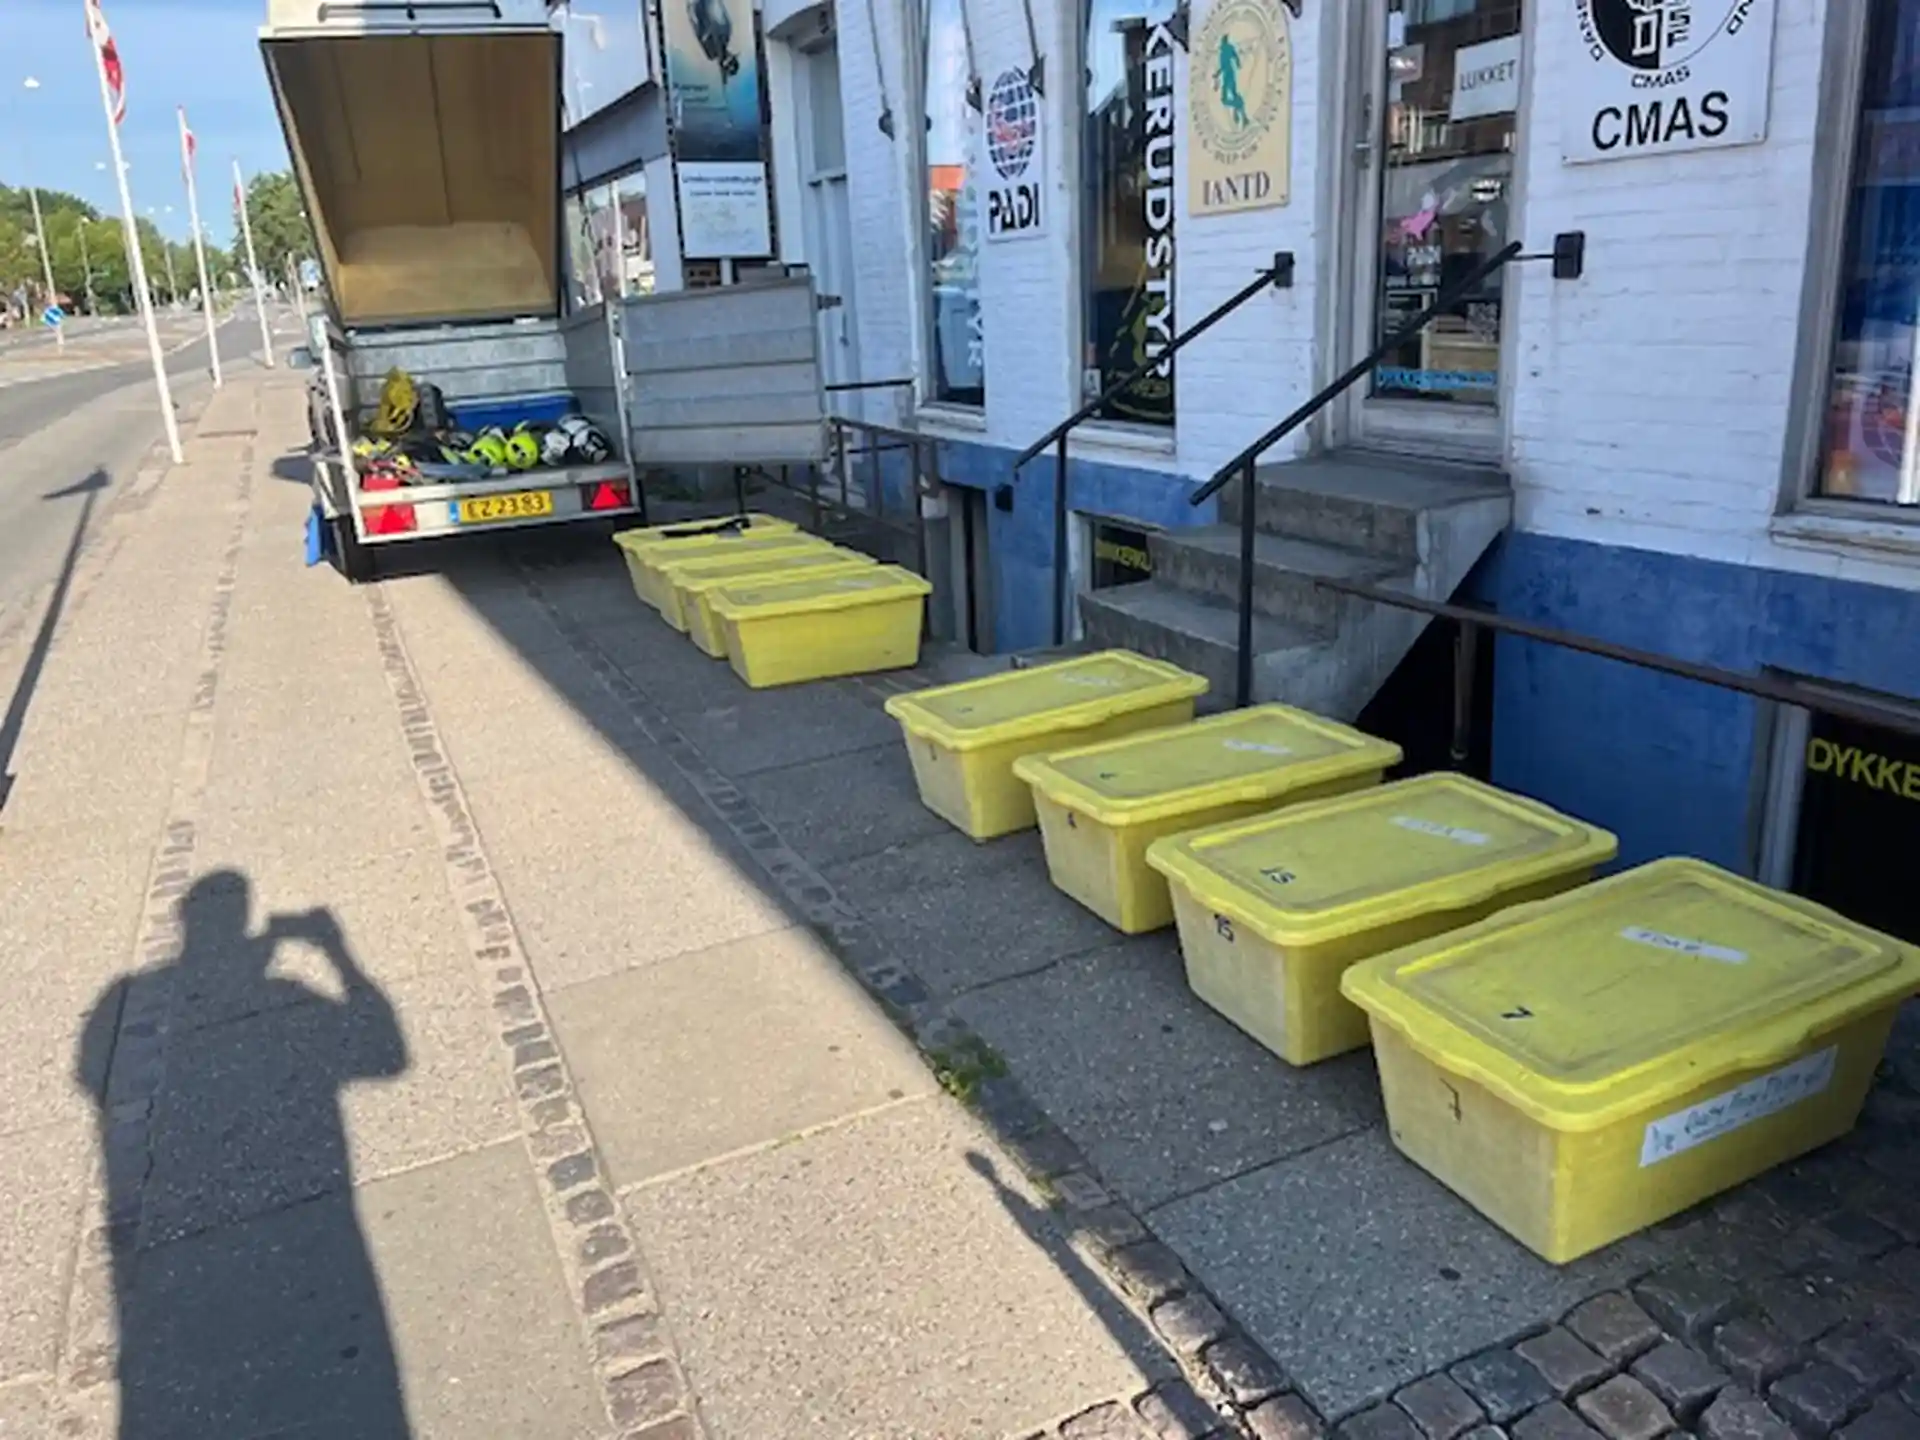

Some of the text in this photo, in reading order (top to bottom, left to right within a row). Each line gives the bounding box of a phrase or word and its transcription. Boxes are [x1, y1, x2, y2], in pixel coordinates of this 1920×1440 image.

[1631, 66, 1691, 89] CMAS
[1592, 90, 1729, 151] CMAS
[988, 181, 1040, 235] PADI
[1203, 170, 1271, 206] IANTD
